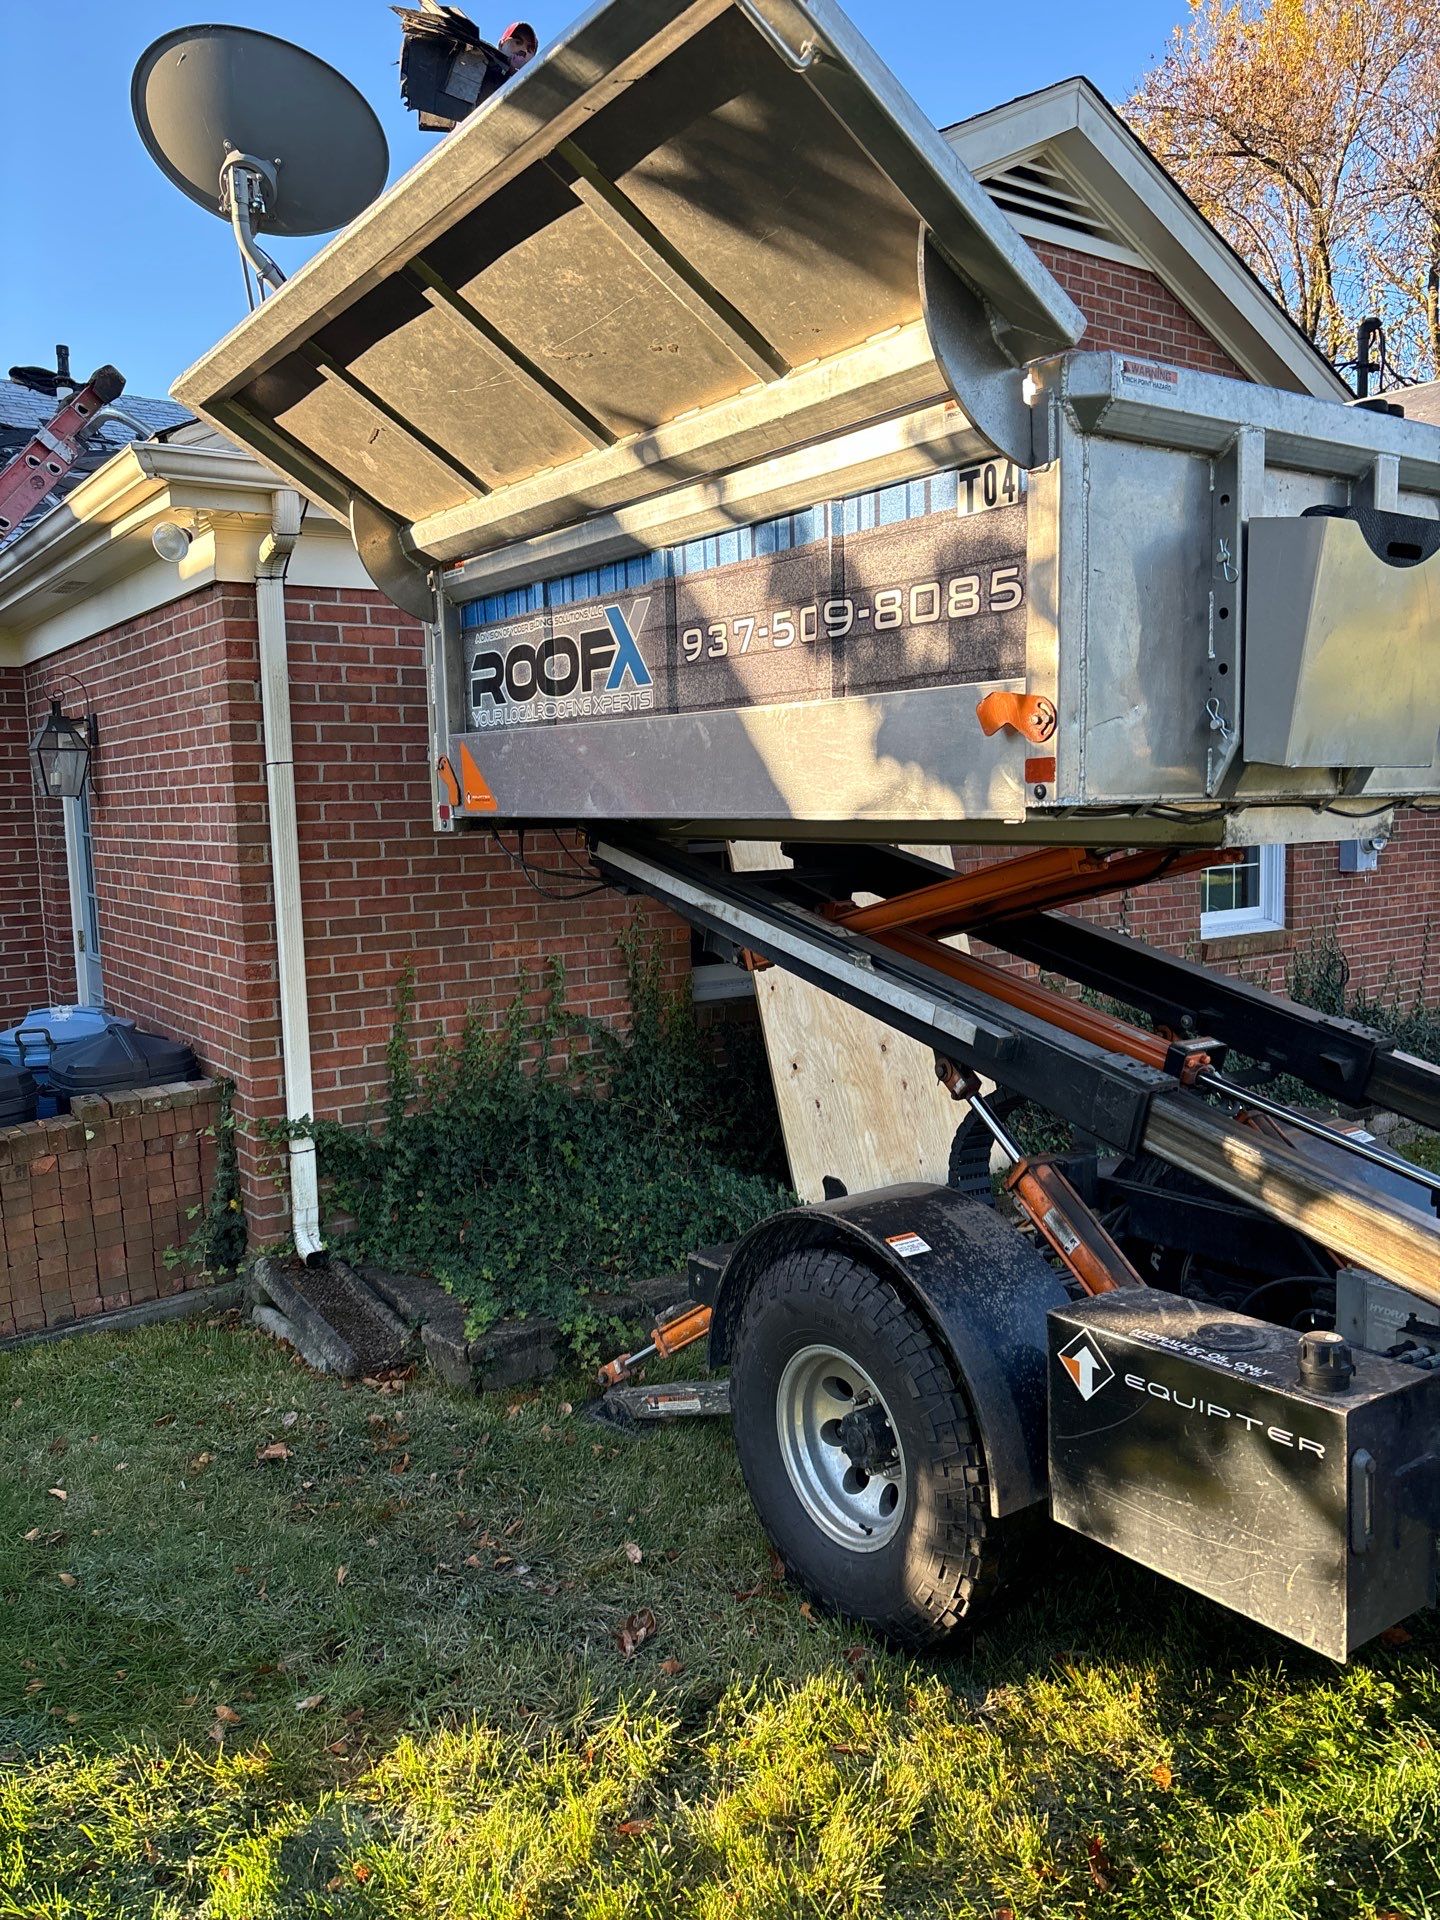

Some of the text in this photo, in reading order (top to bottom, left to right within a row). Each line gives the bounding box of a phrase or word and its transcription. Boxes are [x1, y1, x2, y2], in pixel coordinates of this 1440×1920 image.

[1131, 363, 1172, 381] WARNING
[1138, 378, 1152, 387] POINT
[1152, 382, 1172, 391] HAZARD
[959, 461, 1016, 514] T04
[589, 604, 604, 620] LLC
[682, 567, 1024, 663] 937-509-8085
[470, 597, 653, 709] ROOFX
[472, 708, 504, 728] YOUR
[505, 703, 539, 725] LOCAL
[537, 696, 592, 720] ROOFING
[1130, 1328, 1206, 1353] HYDRAULIC
[1207, 1352, 1230, 1364] OIL
[1235, 1361, 1275, 1376] ONLY
[1124, 1373, 1326, 1460] EQUIPTER
